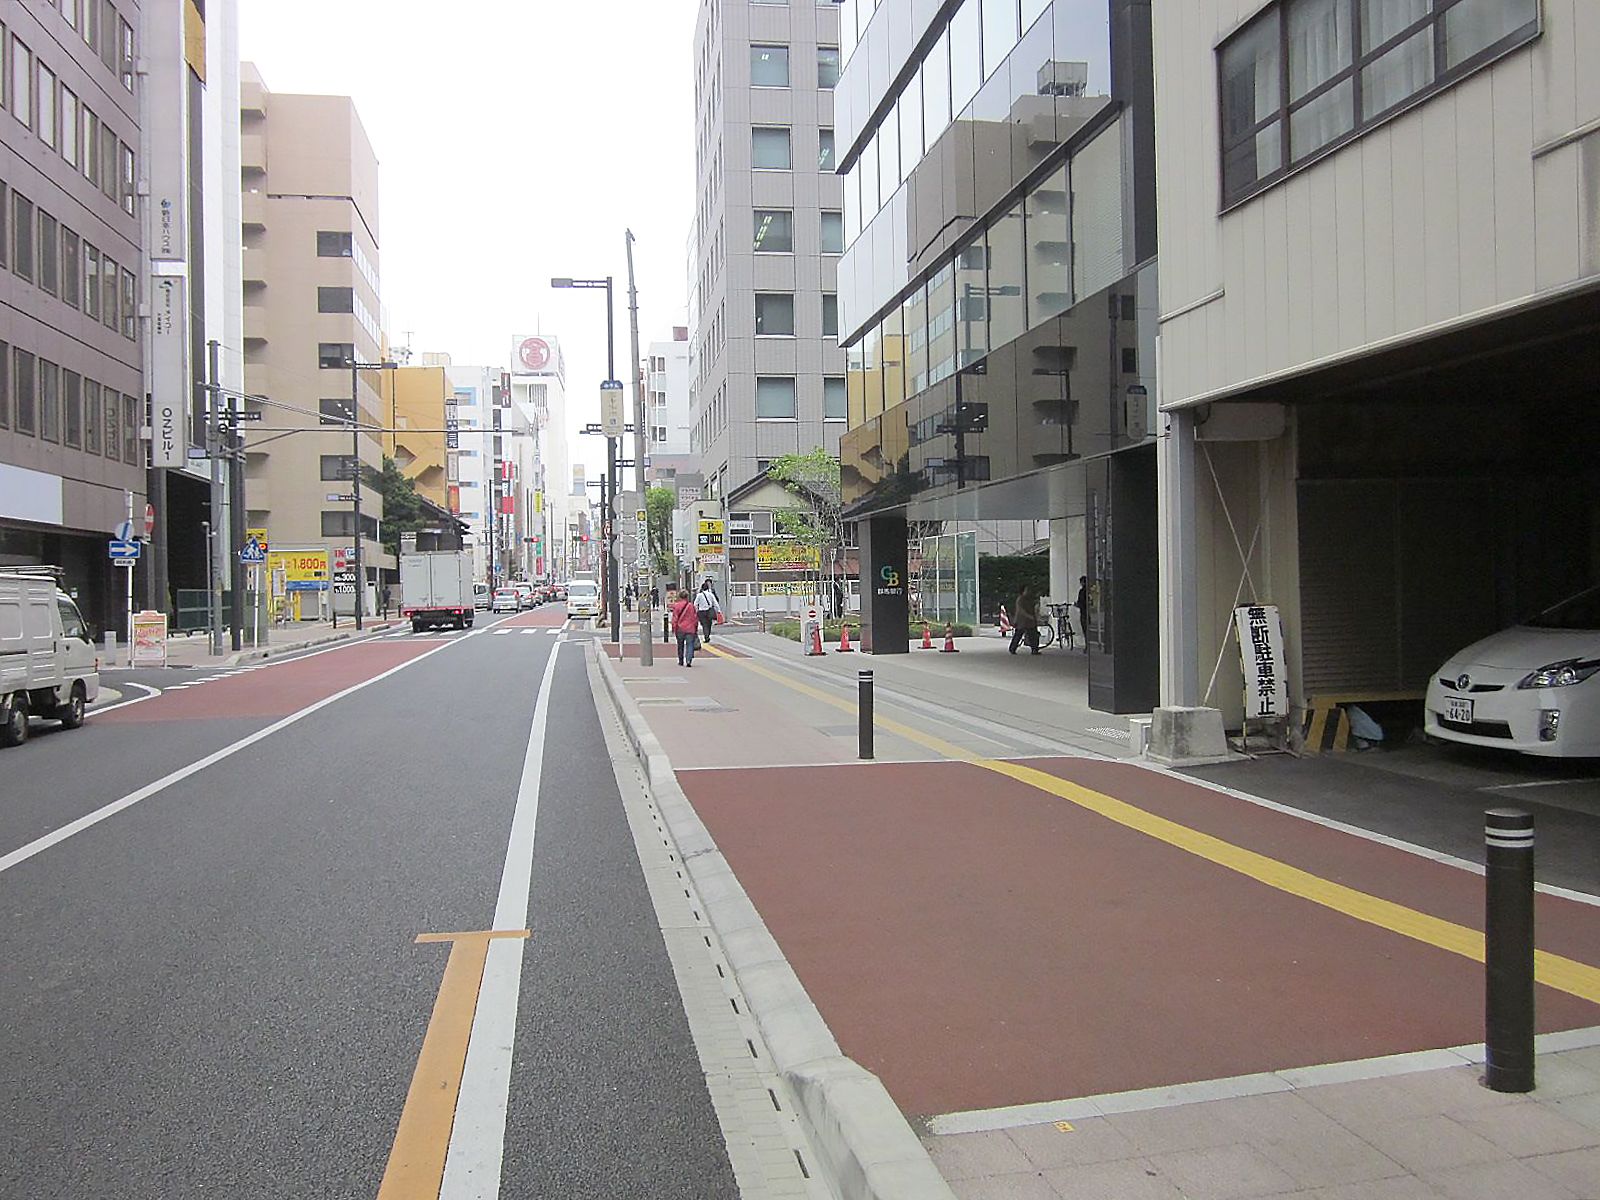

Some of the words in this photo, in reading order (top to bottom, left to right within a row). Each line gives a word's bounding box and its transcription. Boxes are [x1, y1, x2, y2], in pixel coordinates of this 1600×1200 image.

[1247, 607, 1276, 716] 無断駐車禁止
